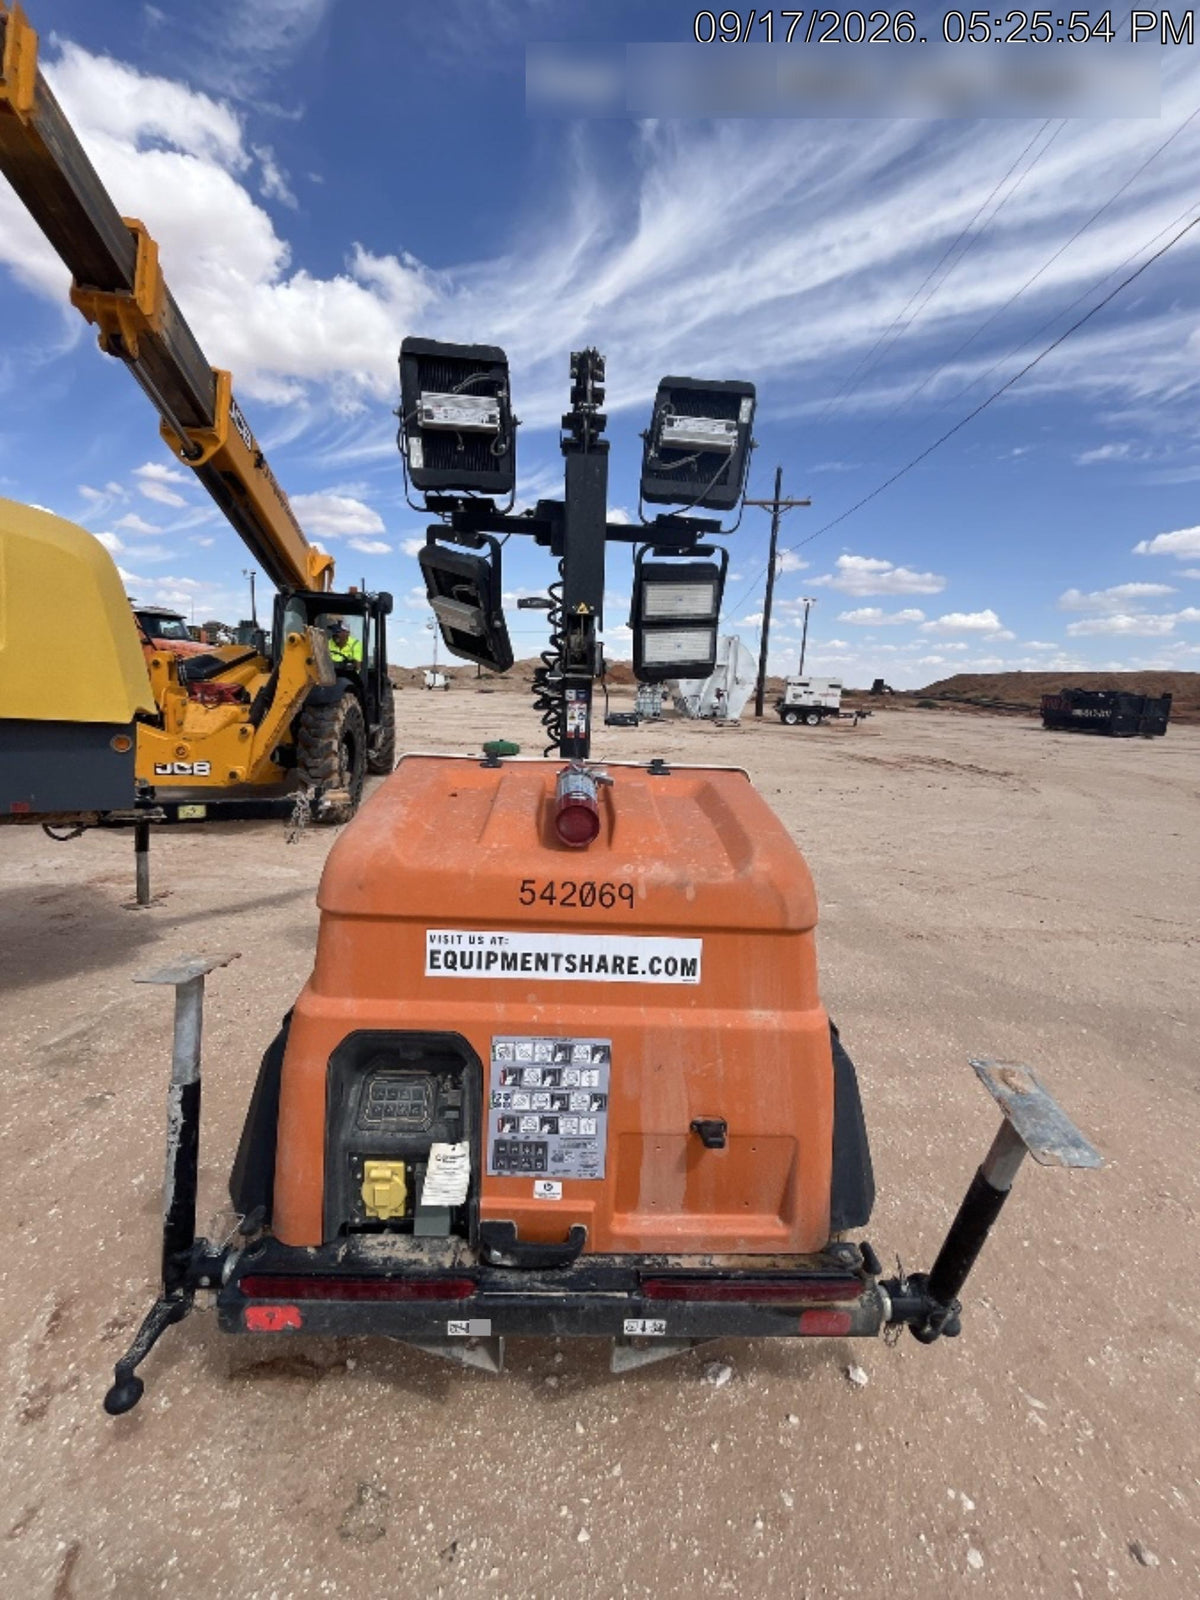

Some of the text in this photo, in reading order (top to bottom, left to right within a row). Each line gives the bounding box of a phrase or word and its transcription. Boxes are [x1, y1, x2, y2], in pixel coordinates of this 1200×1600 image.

[154, 761, 212, 777] JCB
[519, 879, 634, 909] 542069
[429, 934, 510, 946] VISIT US AT:
[429, 949, 698, 977] EQUIPMENTSHARE.COM
